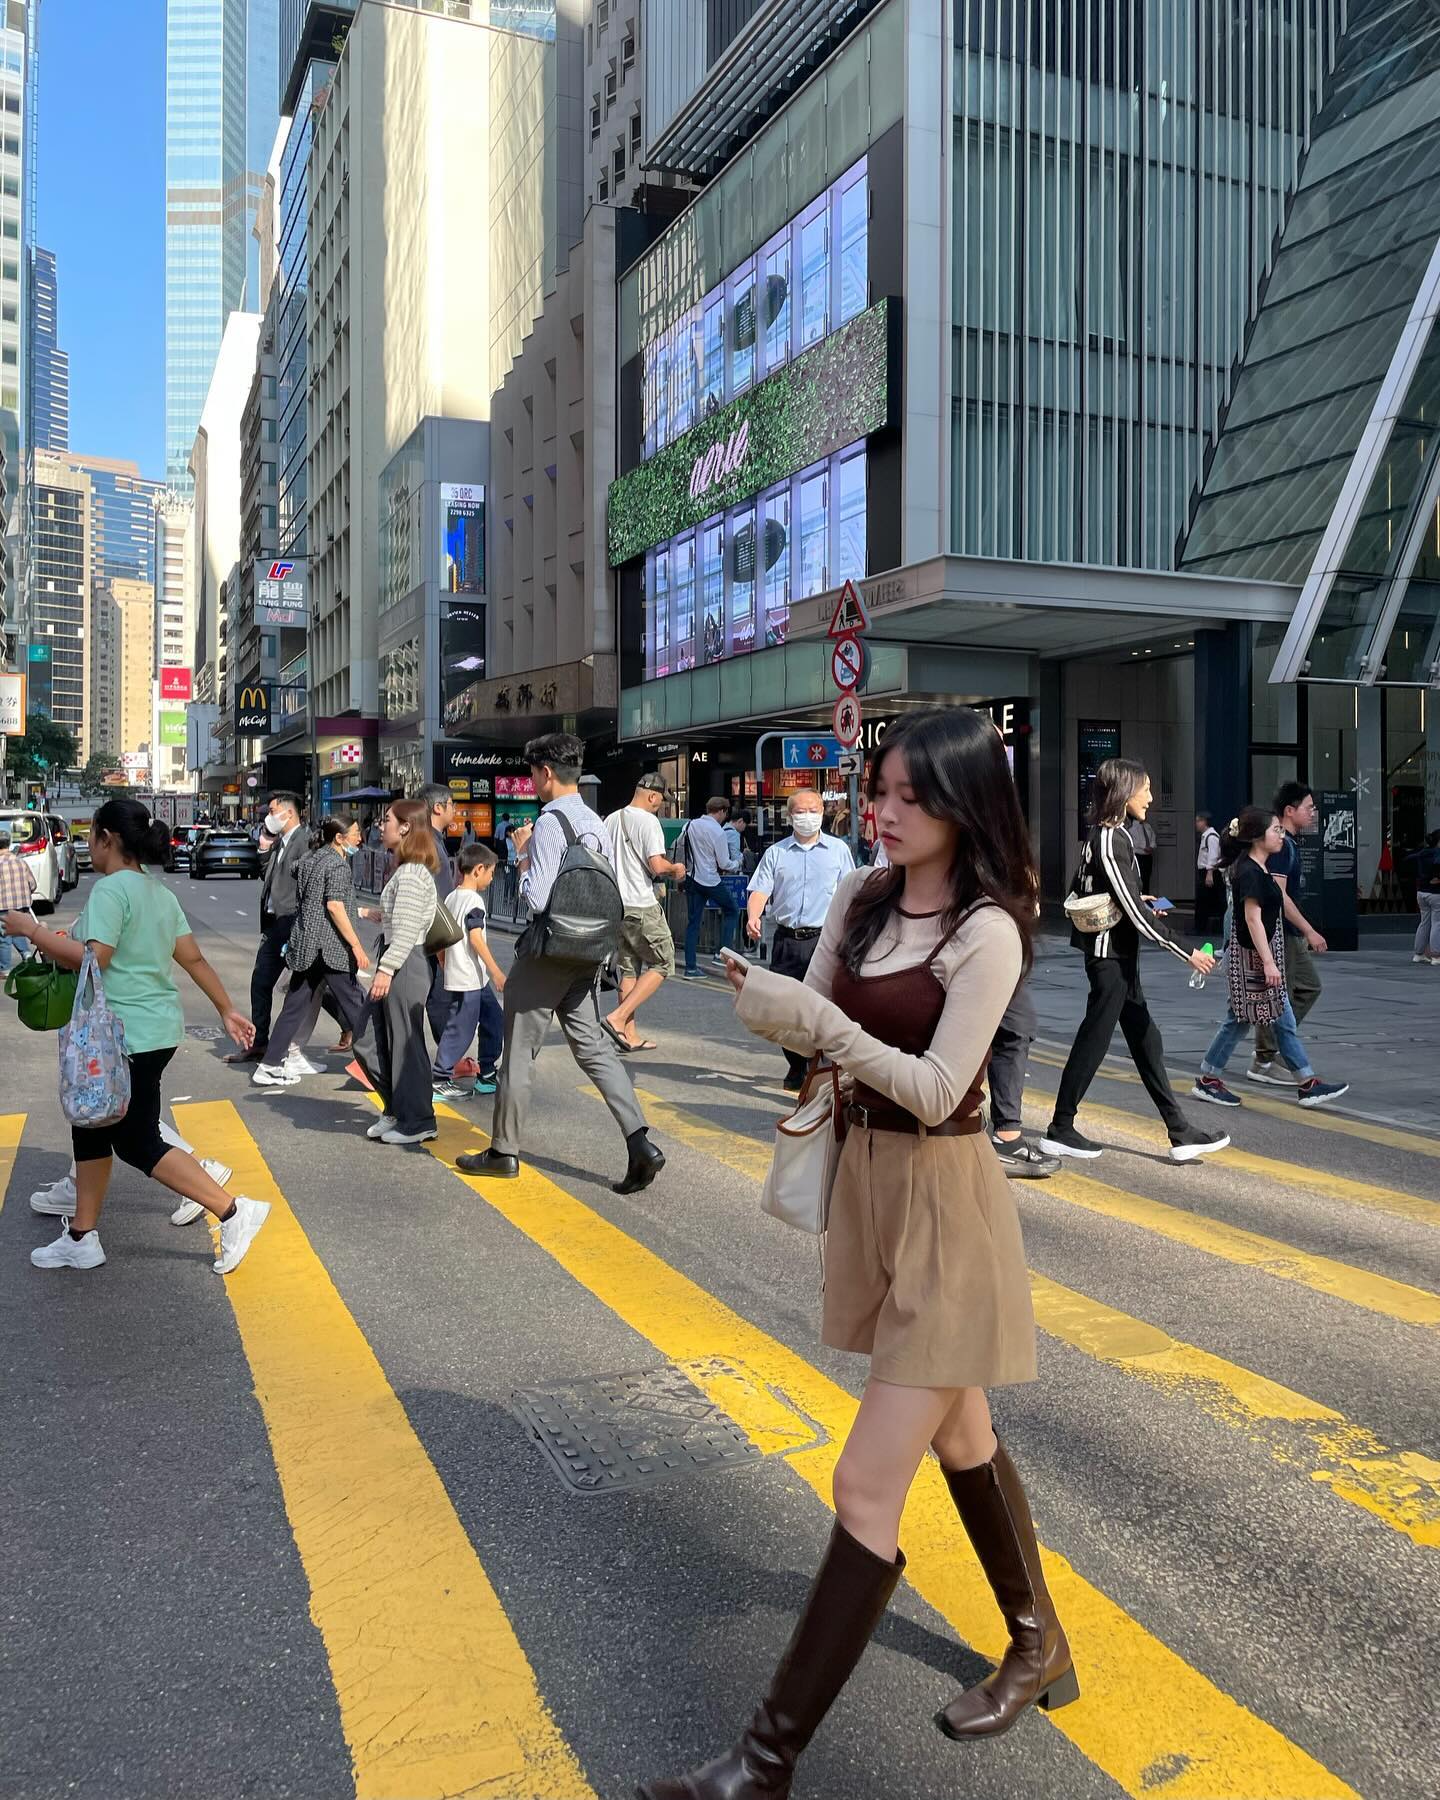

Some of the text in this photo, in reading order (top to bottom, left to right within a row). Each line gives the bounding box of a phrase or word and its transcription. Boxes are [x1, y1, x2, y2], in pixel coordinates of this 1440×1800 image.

[258, 599, 304, 609] LUNG FUNG
[450, 751, 503, 768] Homebake
[692, 751, 708, 762] AE
